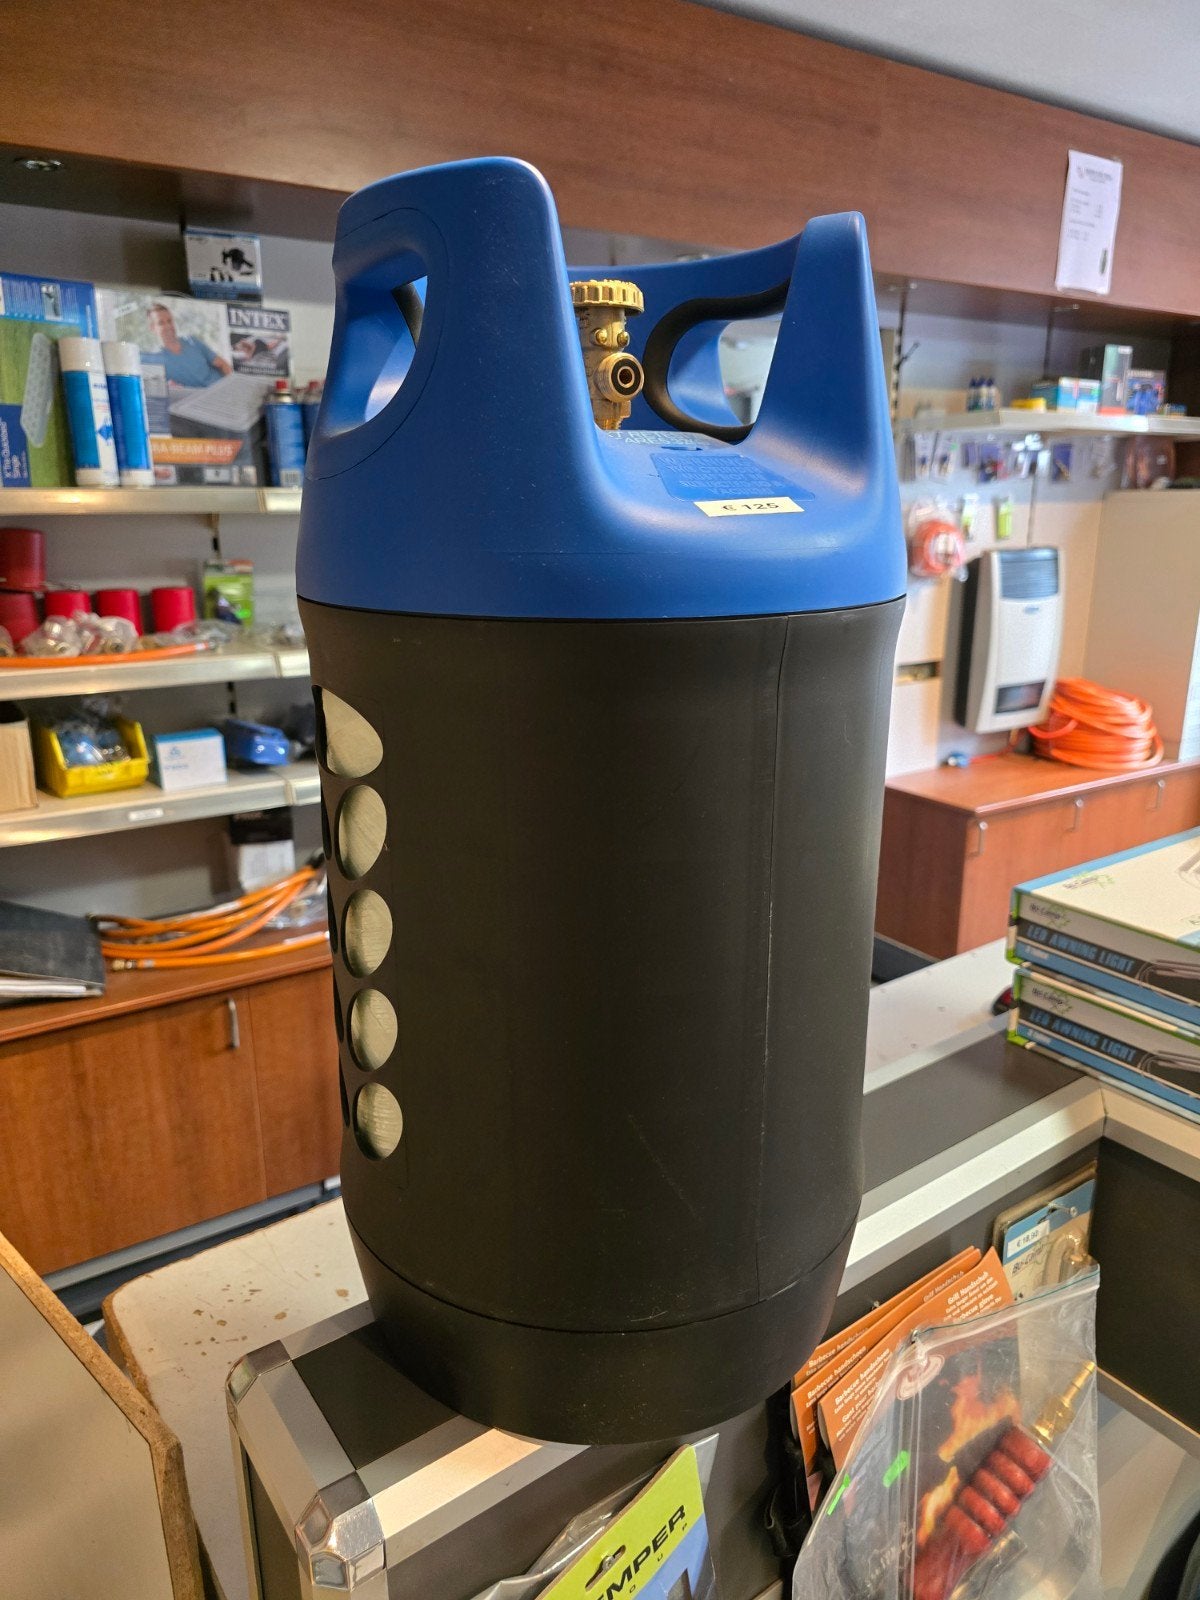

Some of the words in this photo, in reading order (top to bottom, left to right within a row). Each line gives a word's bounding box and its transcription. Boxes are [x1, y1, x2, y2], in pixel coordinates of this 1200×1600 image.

[229, 308, 287, 329] INTEX
[741, 502, 780, 510] 125
[1027, 924, 1049, 942] LED
[1049, 934, 1099, 961] AWNING
[1099, 949, 1135, 972] LIGHT
[1028, 1007, 1051, 1026] LED
[1051, 1017, 1100, 1047] AWNING
[1100, 1038, 1137, 1062] LIGHT
[947, 1292, 960, 1305] Grill
[960, 1271, 989, 1296] Handschuh
[809, 1349, 836, 1368] Barbecue
[808, 1374, 834, 1399] Barbecue
[835, 1379, 860, 1405] Barbecue
[842, 1407, 855, 1422] Gant
